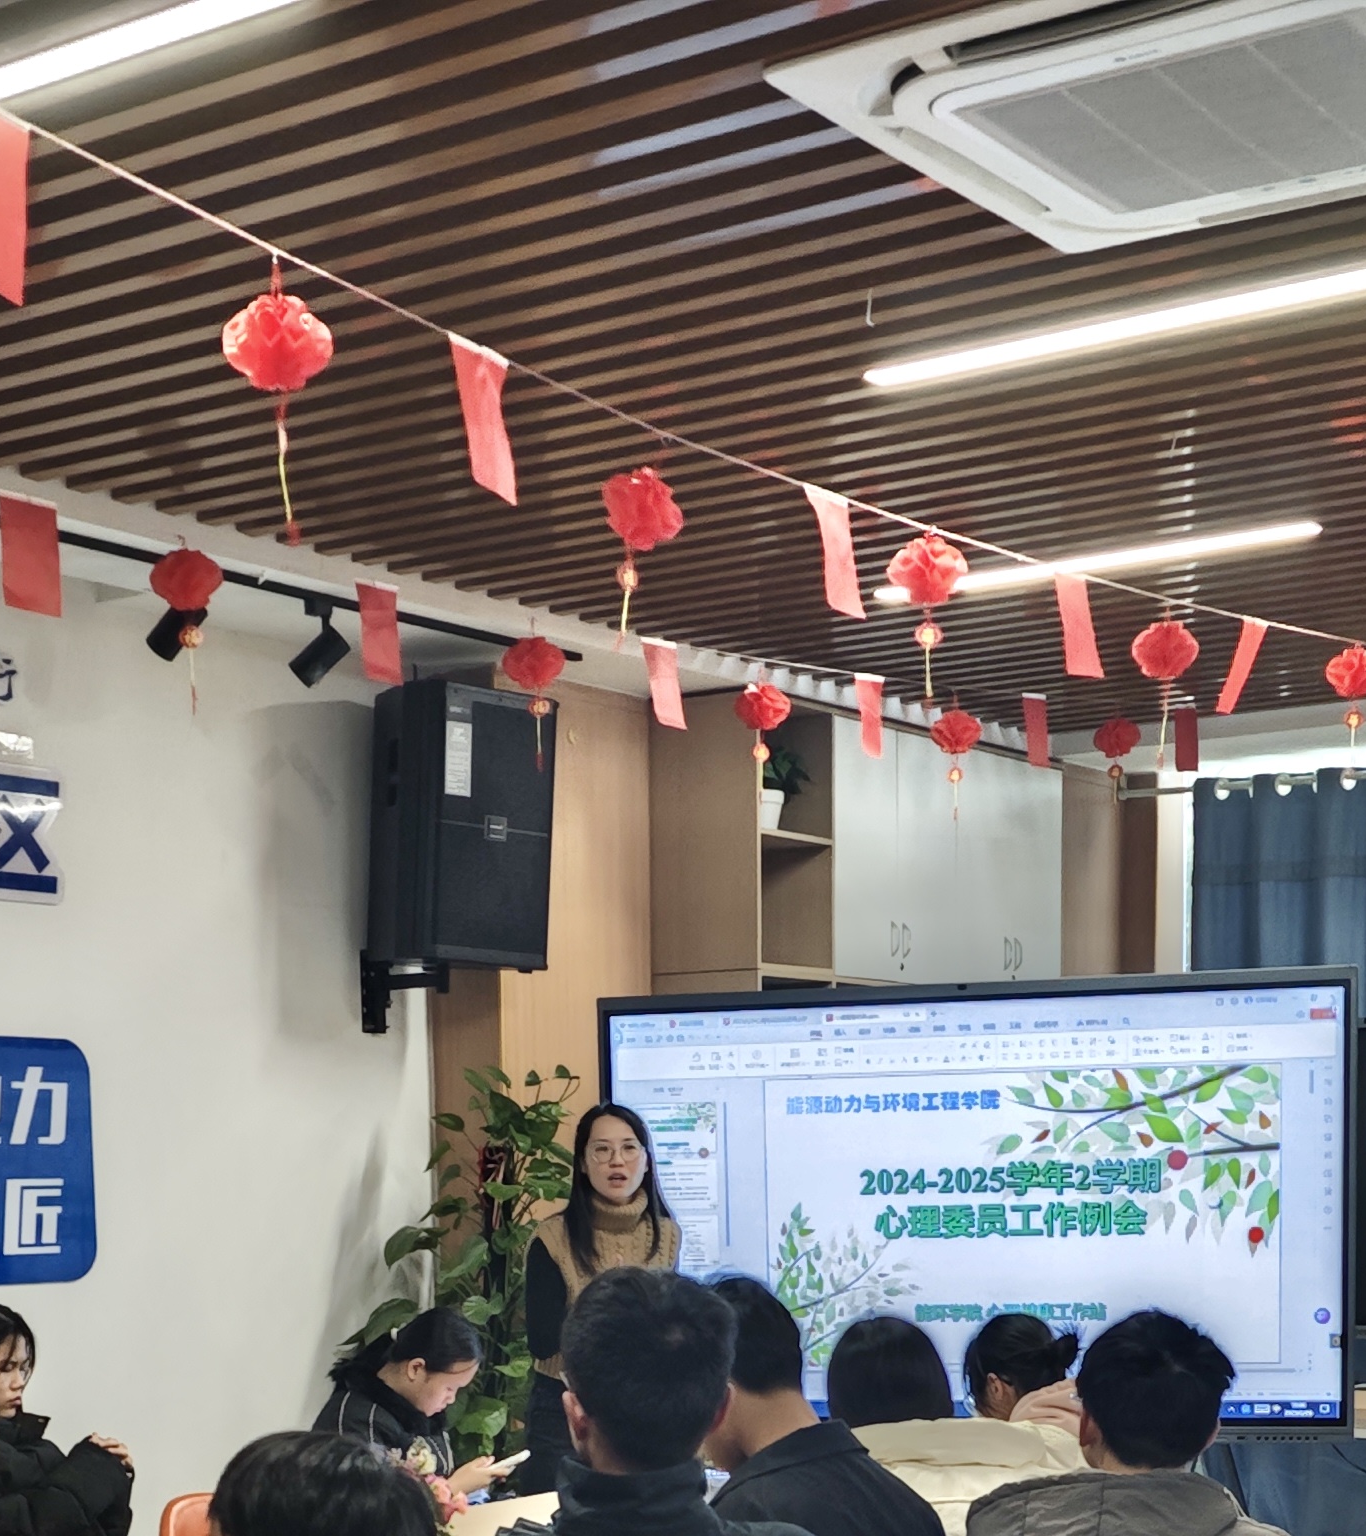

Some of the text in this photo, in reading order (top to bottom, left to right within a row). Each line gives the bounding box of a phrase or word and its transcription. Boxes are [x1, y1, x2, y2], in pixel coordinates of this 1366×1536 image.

[786, 1090, 1001, 1115] 能源动力与环境工程学院
[859, 1158, 1162, 1196] 2024-2025学年2学期
[875, 1201, 1148, 1240] 心理委员工作例会
